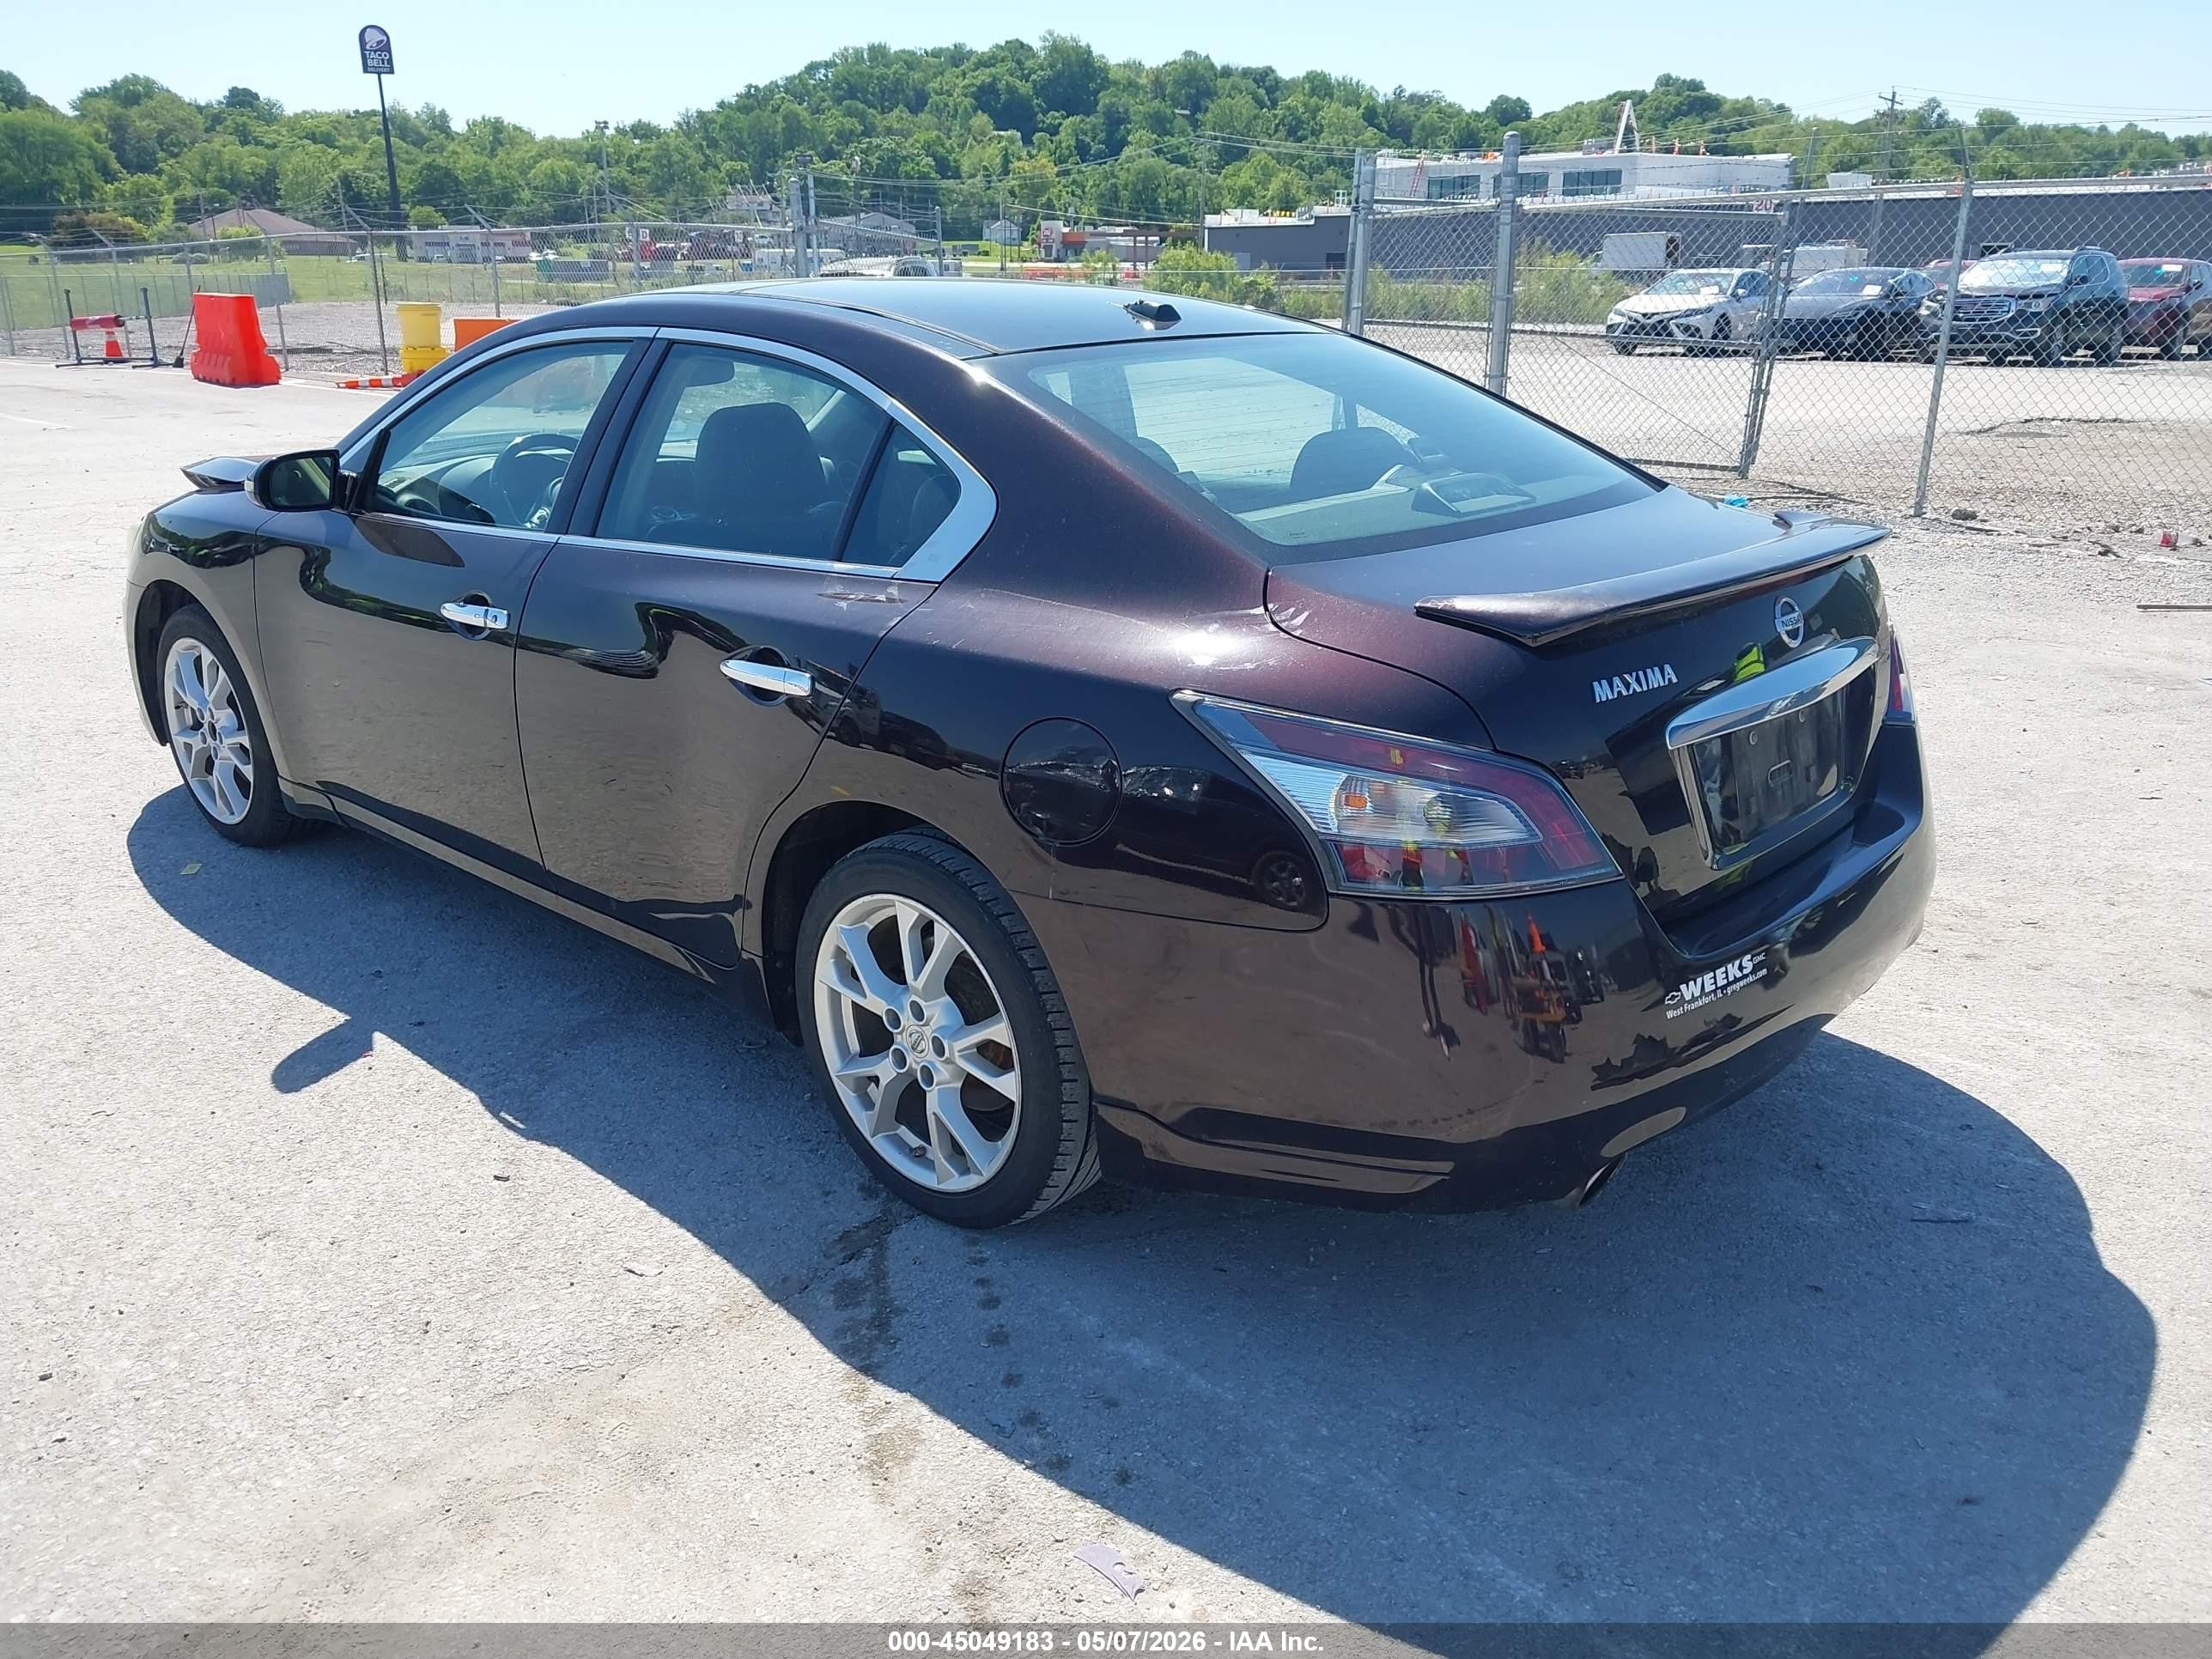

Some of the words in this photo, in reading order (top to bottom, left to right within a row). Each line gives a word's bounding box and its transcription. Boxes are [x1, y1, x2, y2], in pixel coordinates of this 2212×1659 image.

[364, 51, 390, 59] TACO
[1592, 664, 1679, 703] MAXIMA
[1666, 1006, 1684, 1019] West
[1684, 993, 1717, 1012] Frankfort,
[1717, 989, 1723, 999] IL
[1727, 968, 1768, 996] gregweeks.com
[1680, 954, 1753, 1001] WEEKS
[1753, 952, 1766, 964] GMC
